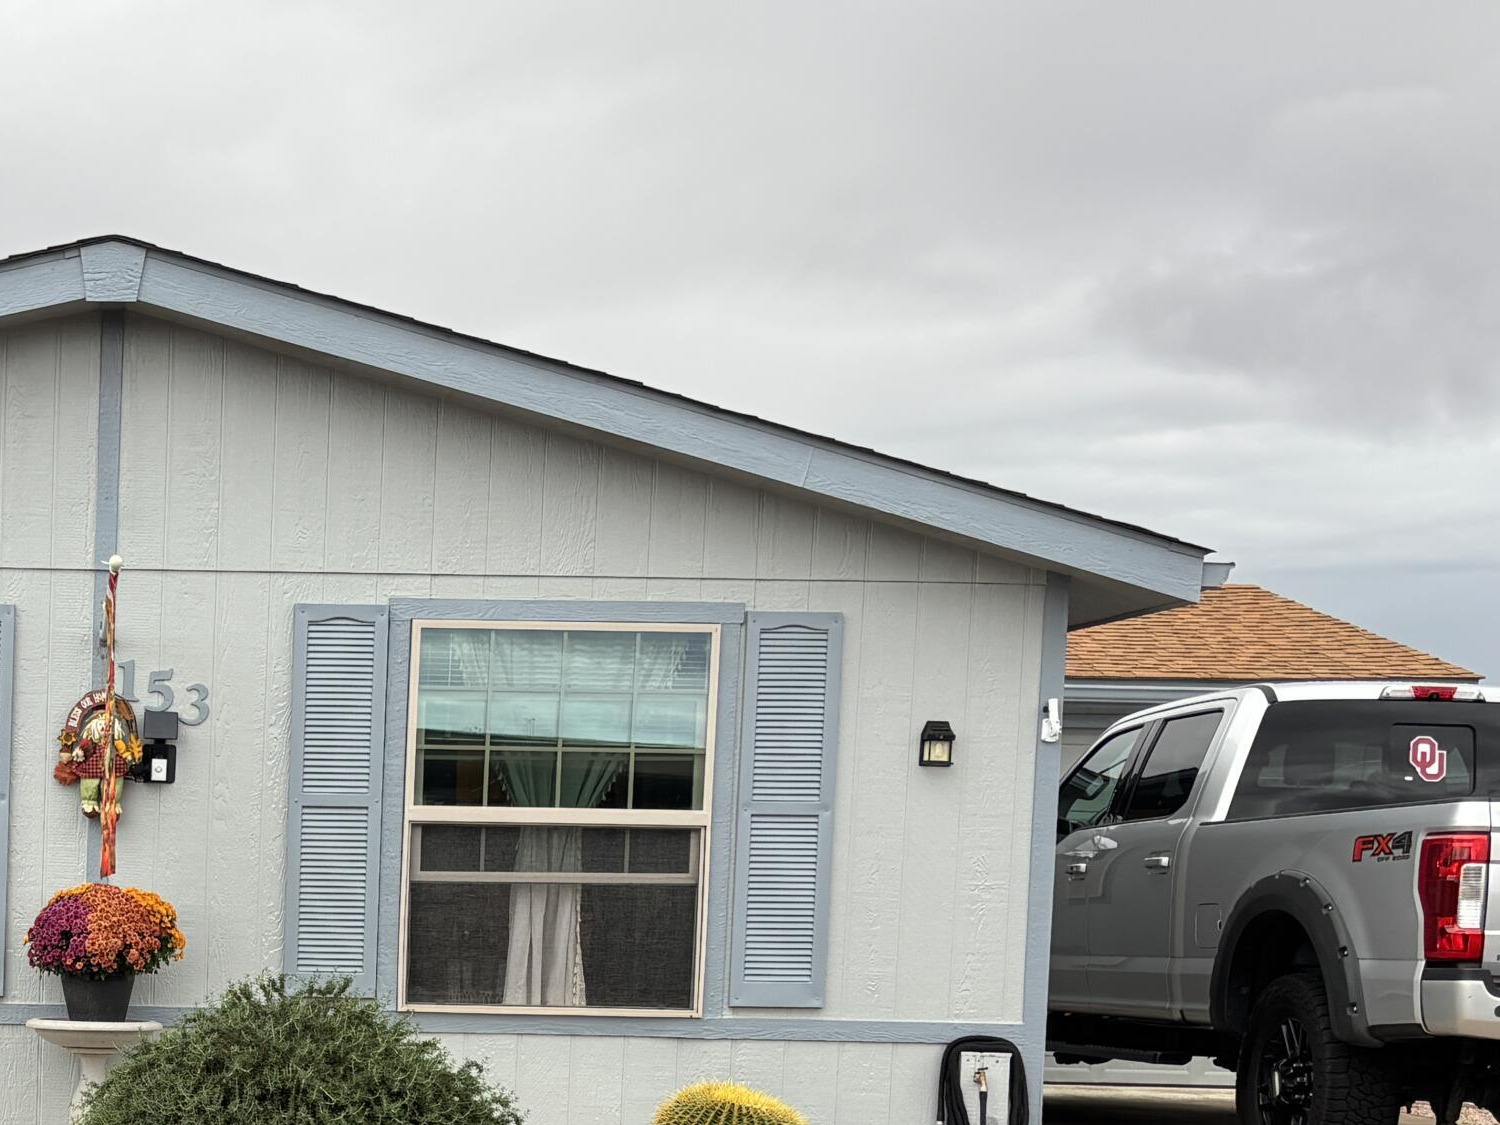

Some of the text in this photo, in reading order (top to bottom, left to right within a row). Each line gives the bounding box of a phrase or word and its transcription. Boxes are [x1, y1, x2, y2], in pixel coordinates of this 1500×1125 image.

[116, 660, 210, 726] 153
[1410, 736, 1447, 782] OU
[1352, 830, 1413, 862] FX4
